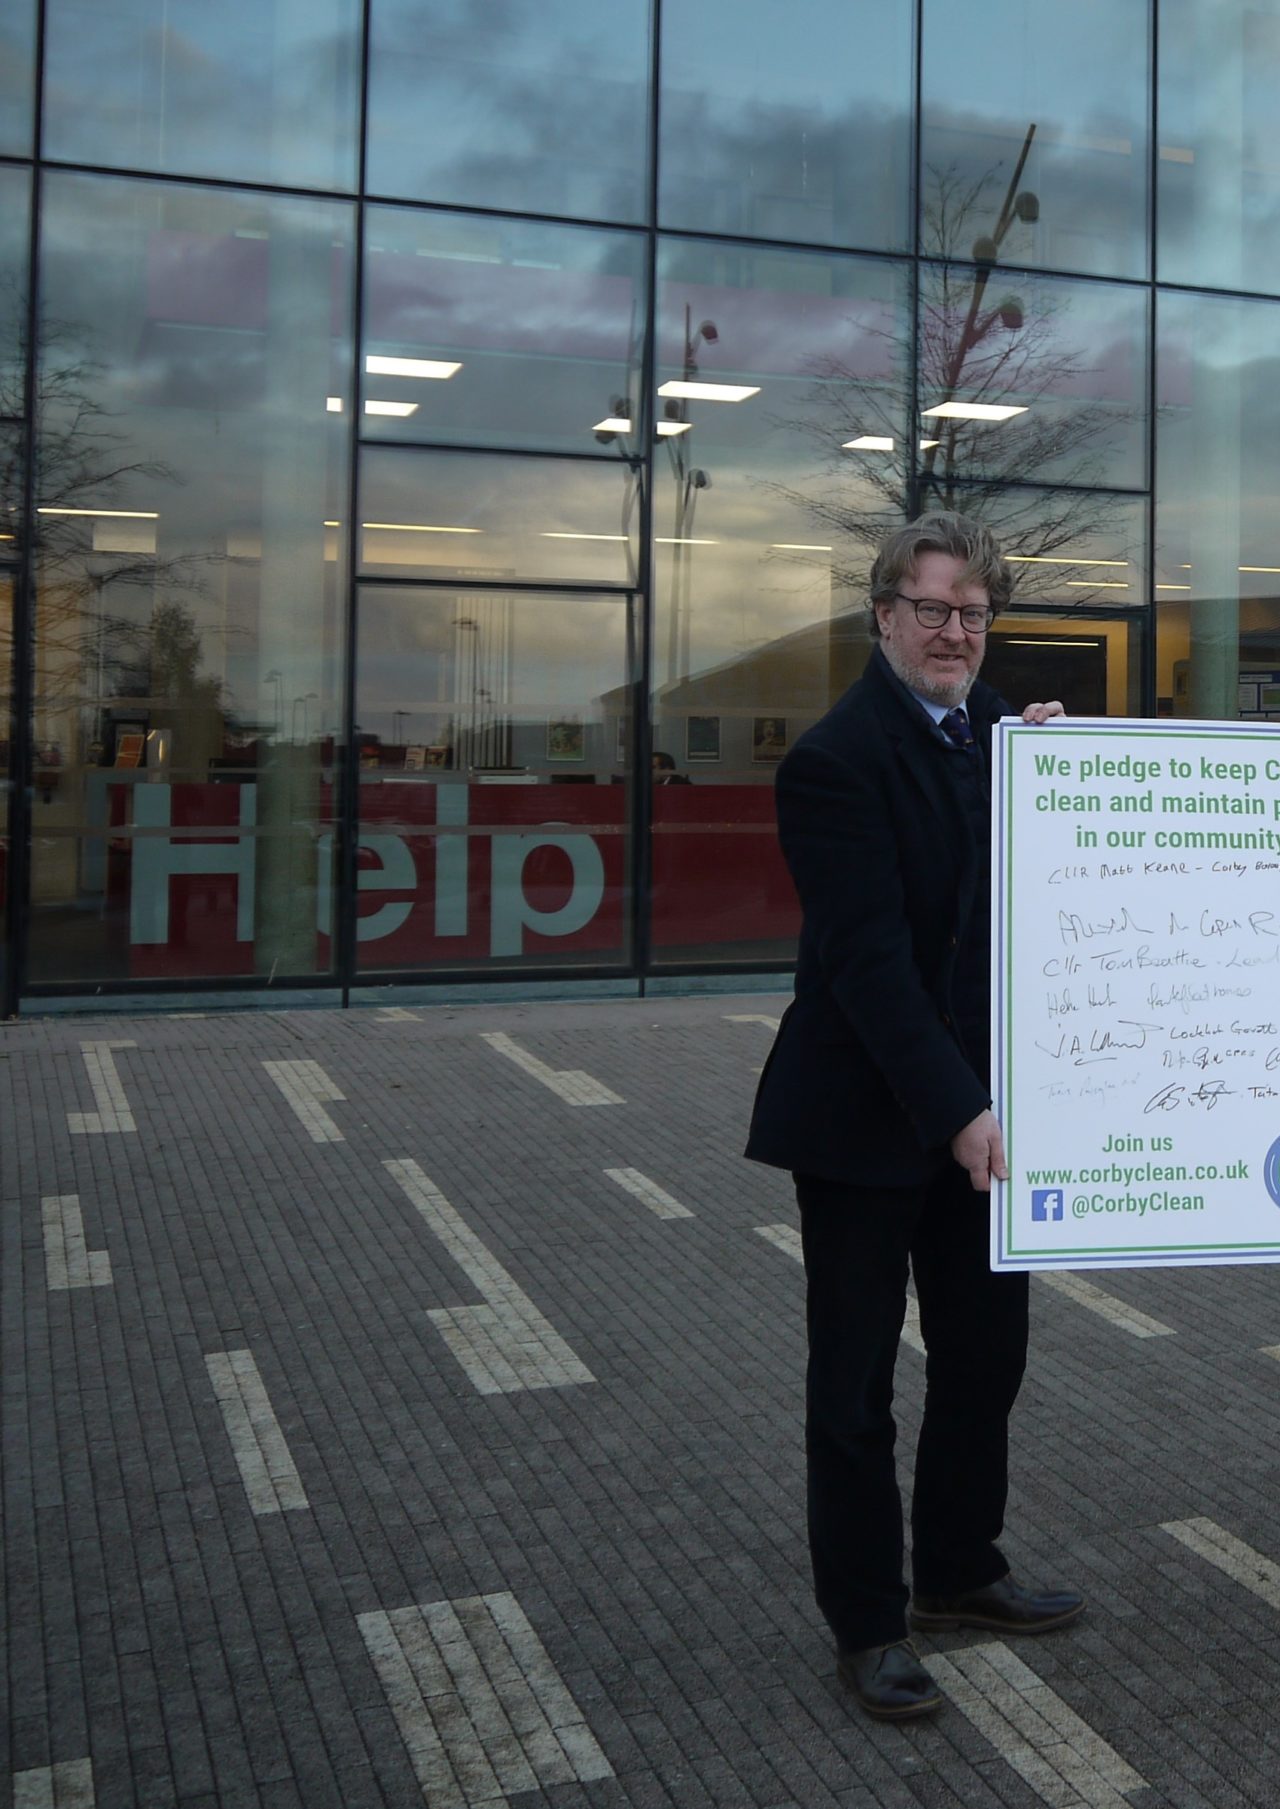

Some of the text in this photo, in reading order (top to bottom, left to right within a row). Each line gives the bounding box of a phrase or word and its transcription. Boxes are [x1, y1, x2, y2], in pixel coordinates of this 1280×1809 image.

[1034, 754, 1071, 777] We
[1079, 754, 1161, 783] pledge
[1169, 757, 1193, 779] to
[1199, 757, 1257, 786] keep
[1035, 788, 1101, 813] clean
[1109, 790, 1154, 814] and
[1161, 791, 1266, 816] maintain
[1076, 825, 1098, 848] in
[1106, 830, 1147, 849] our
[130, 783, 605, 957] Help
[1102, 1133, 1173, 1153] Join us
[1026, 1160, 1249, 1188] www.corbyclean.co.uk
[1071, 1191, 1205, 1219] @CorbyClean
